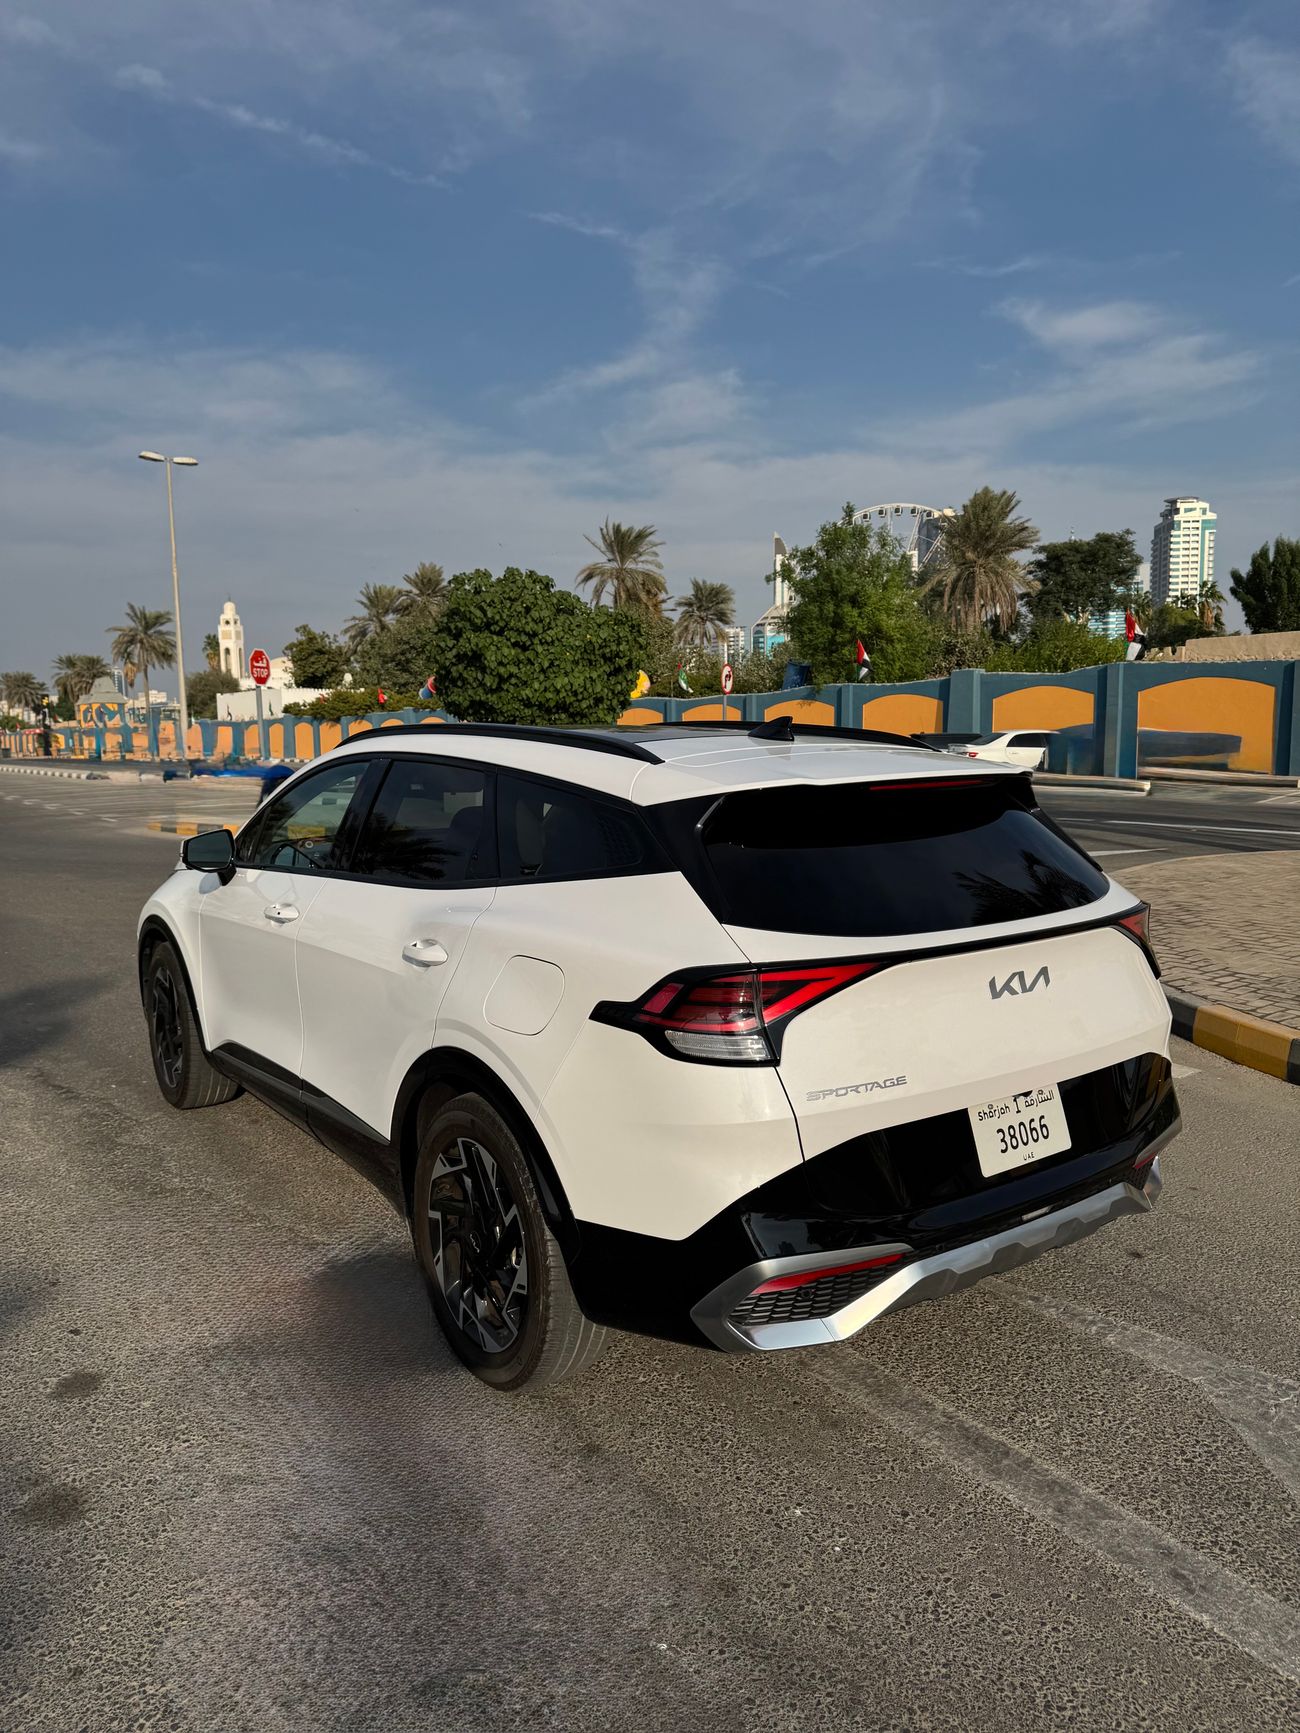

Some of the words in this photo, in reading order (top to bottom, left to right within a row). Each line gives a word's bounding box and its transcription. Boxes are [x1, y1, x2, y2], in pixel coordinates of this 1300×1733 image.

[253, 668, 268, 678] STOP
[989, 966, 1050, 1000] KIA
[806, 1075, 907, 1101] SPORTAGE
[977, 1104, 1010, 1121] Sharjah
[996, 1115, 1049, 1154] 38066
[1023, 1151, 1035, 1161] UAE
